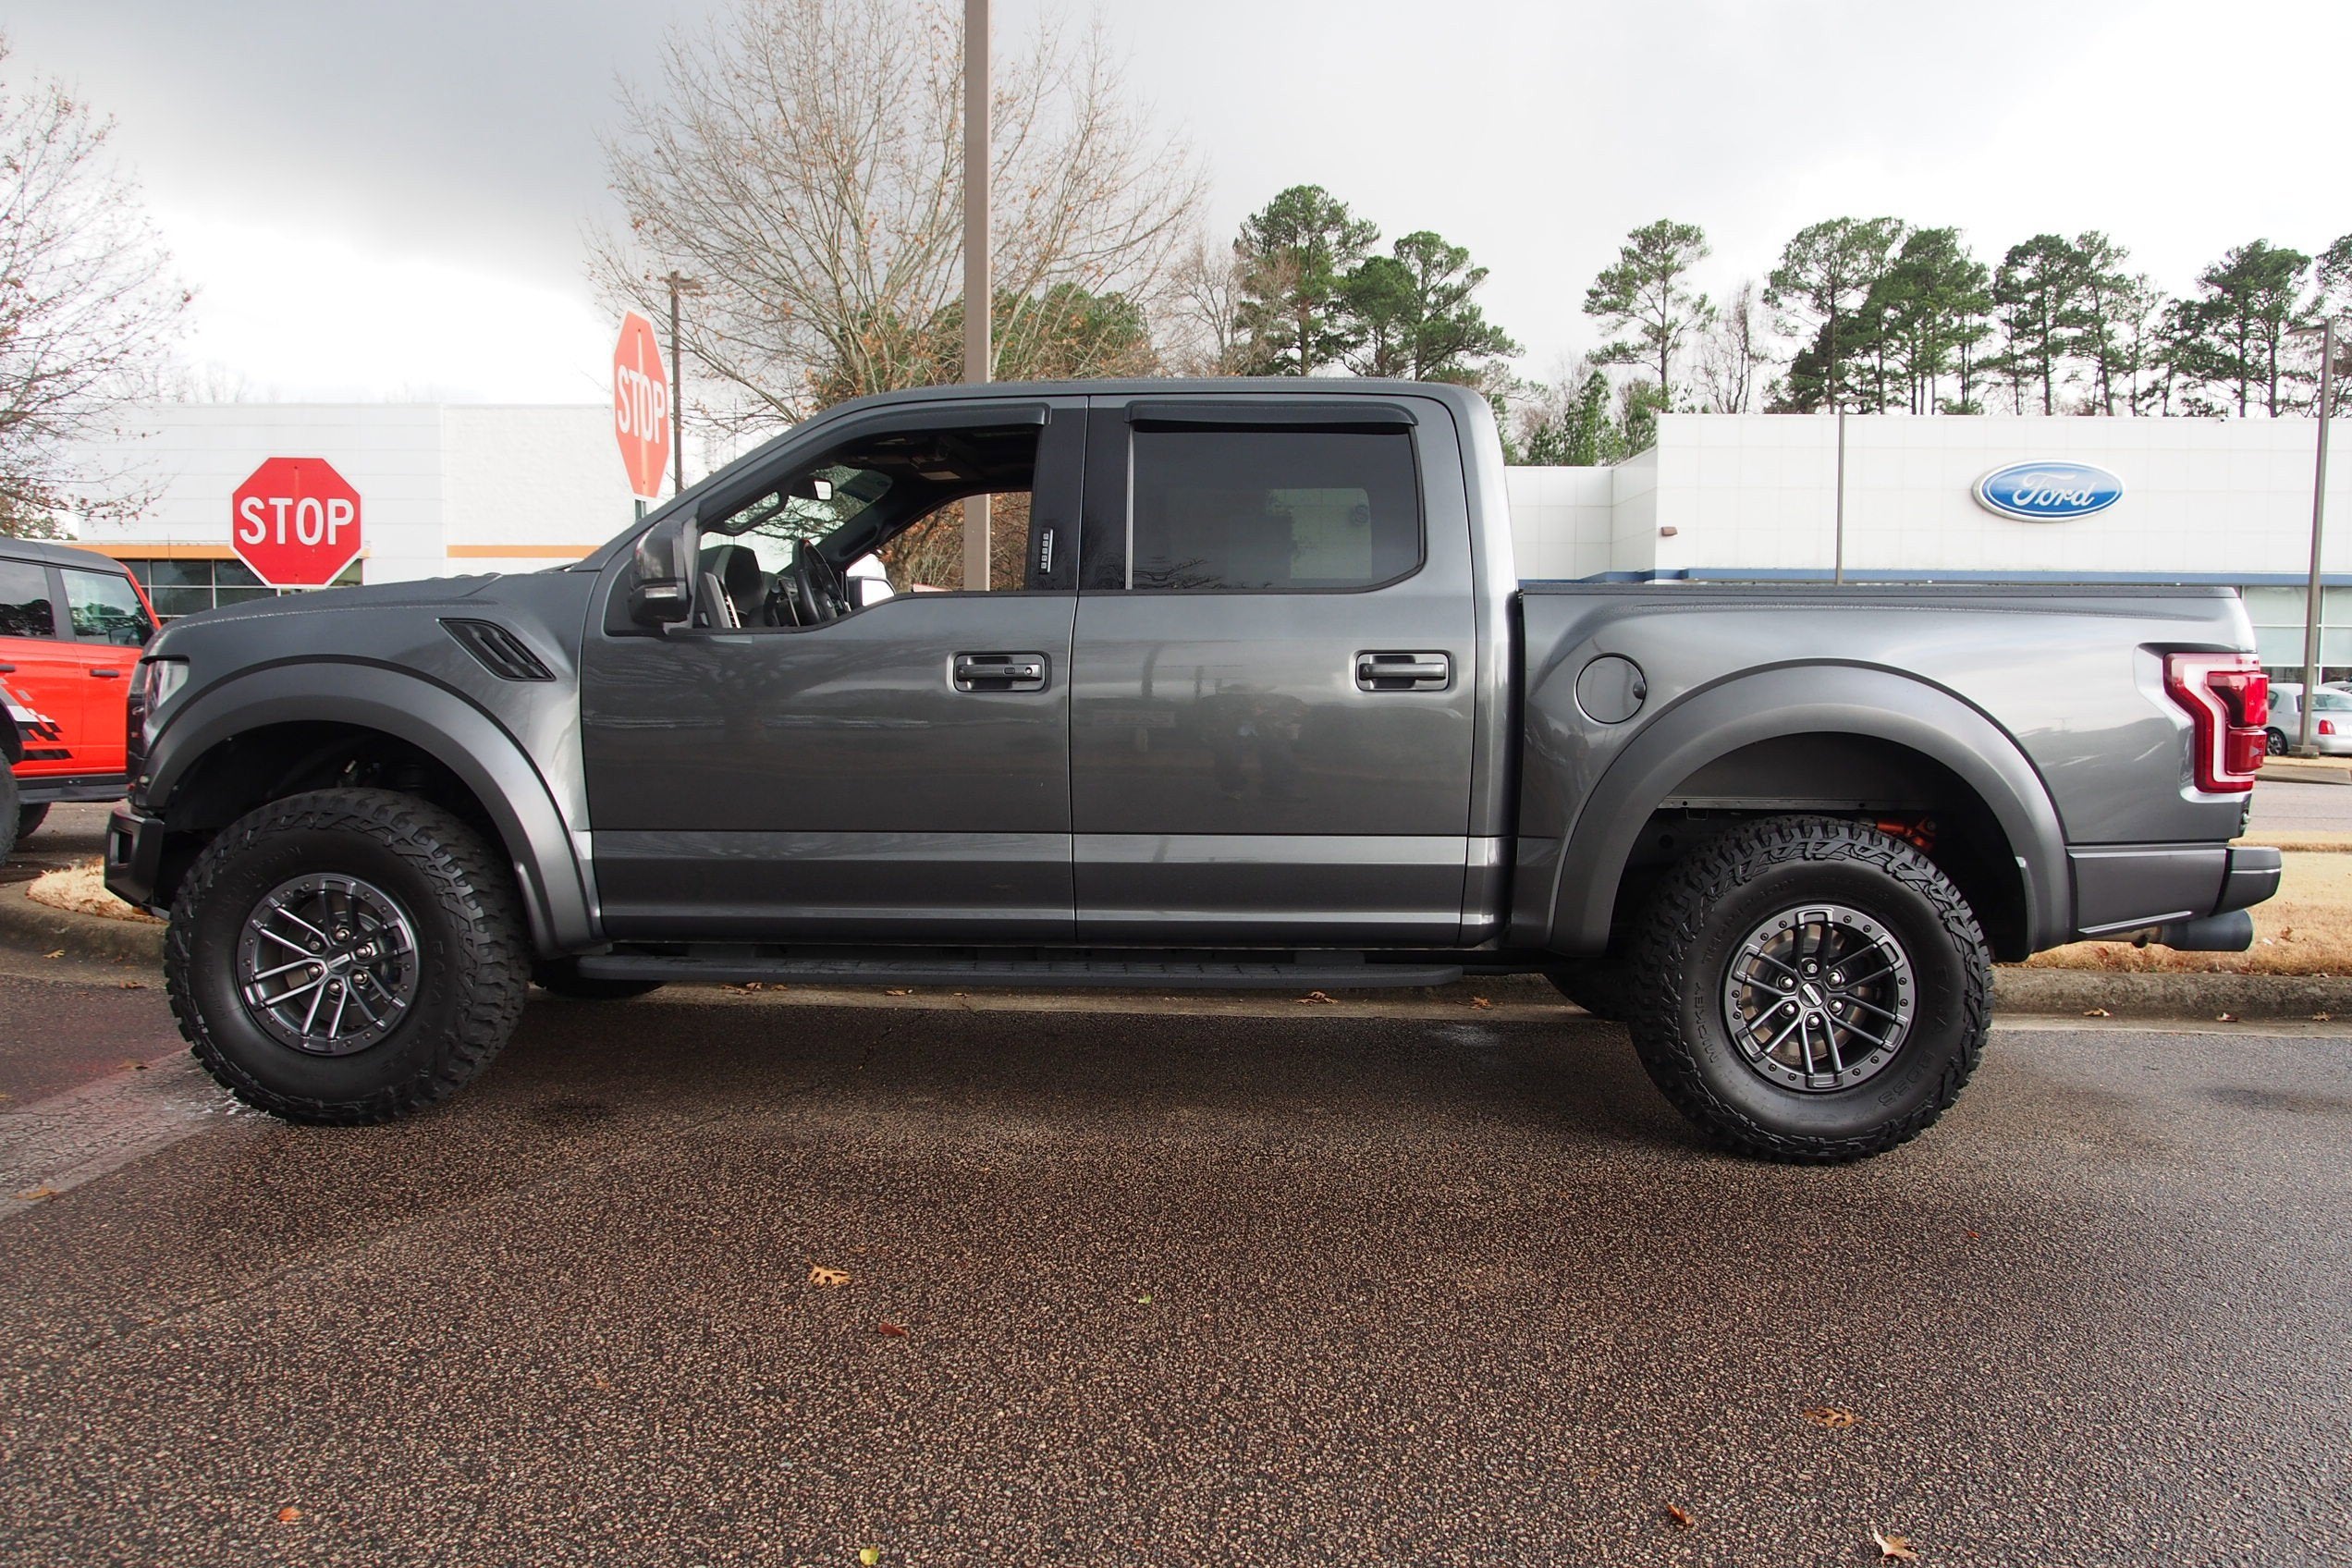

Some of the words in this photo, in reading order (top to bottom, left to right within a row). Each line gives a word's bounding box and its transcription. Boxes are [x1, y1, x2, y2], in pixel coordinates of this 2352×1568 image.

[617, 364, 666, 445] STOP
[2012, 472, 2097, 506] Ford
[239, 496, 355, 545] STOP
